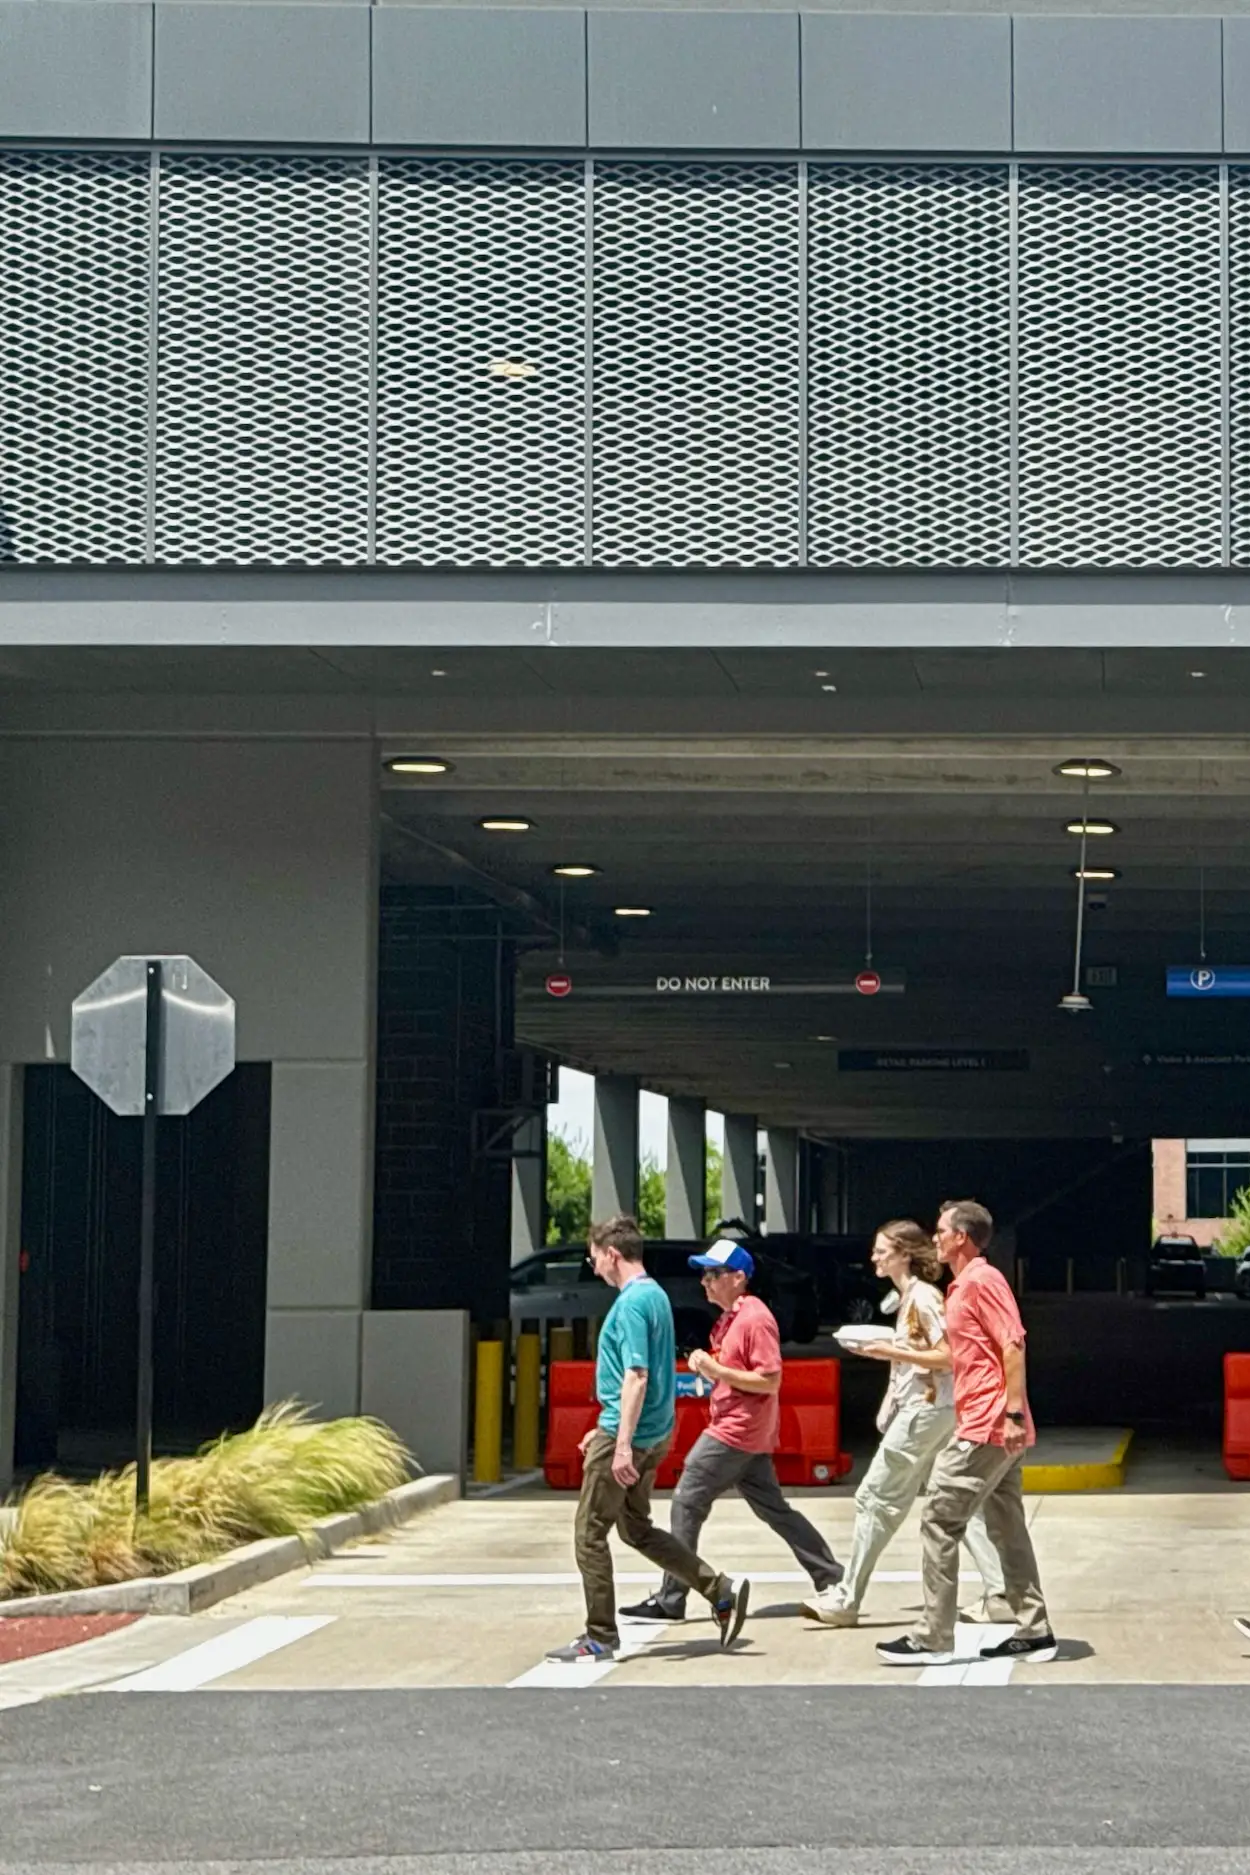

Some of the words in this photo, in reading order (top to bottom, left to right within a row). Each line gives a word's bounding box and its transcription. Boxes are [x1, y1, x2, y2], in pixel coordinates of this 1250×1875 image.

[656, 976, 681, 991] DO
[685, 976, 718, 991] NOT
[721, 976, 770, 991] ENTER
